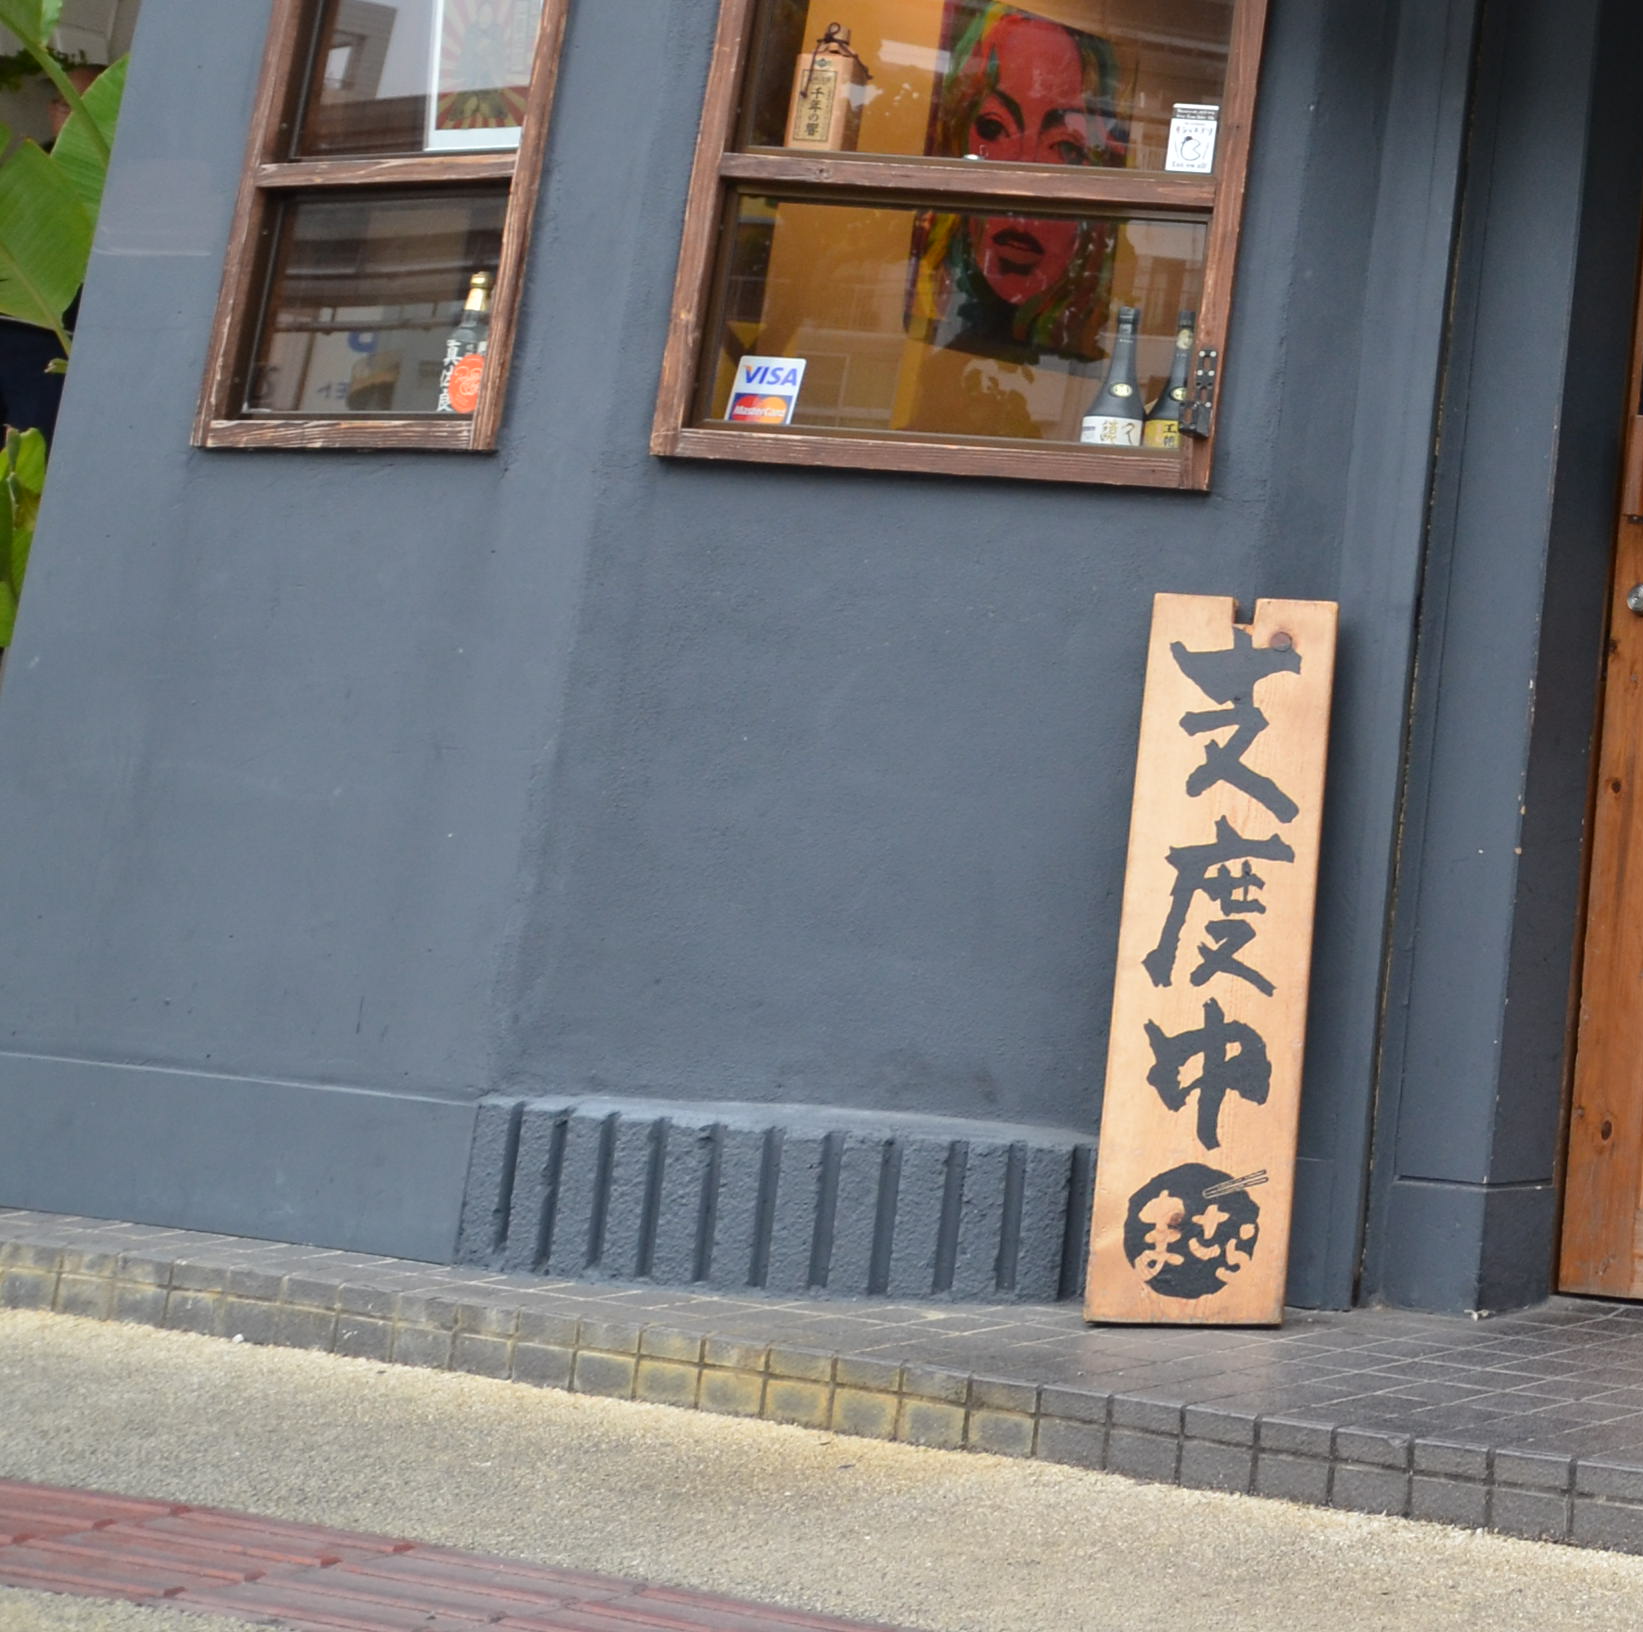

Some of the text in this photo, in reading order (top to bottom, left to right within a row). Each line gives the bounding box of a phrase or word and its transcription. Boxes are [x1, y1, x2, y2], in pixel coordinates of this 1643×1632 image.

[804, 87, 826, 137] 千年の響
[744, 365, 798, 386] VISA
[734, 404, 786, 418] MasterCard
[1141, 624, 1303, 1152] 支度中
[1134, 1188, 1257, 1287] まさら
